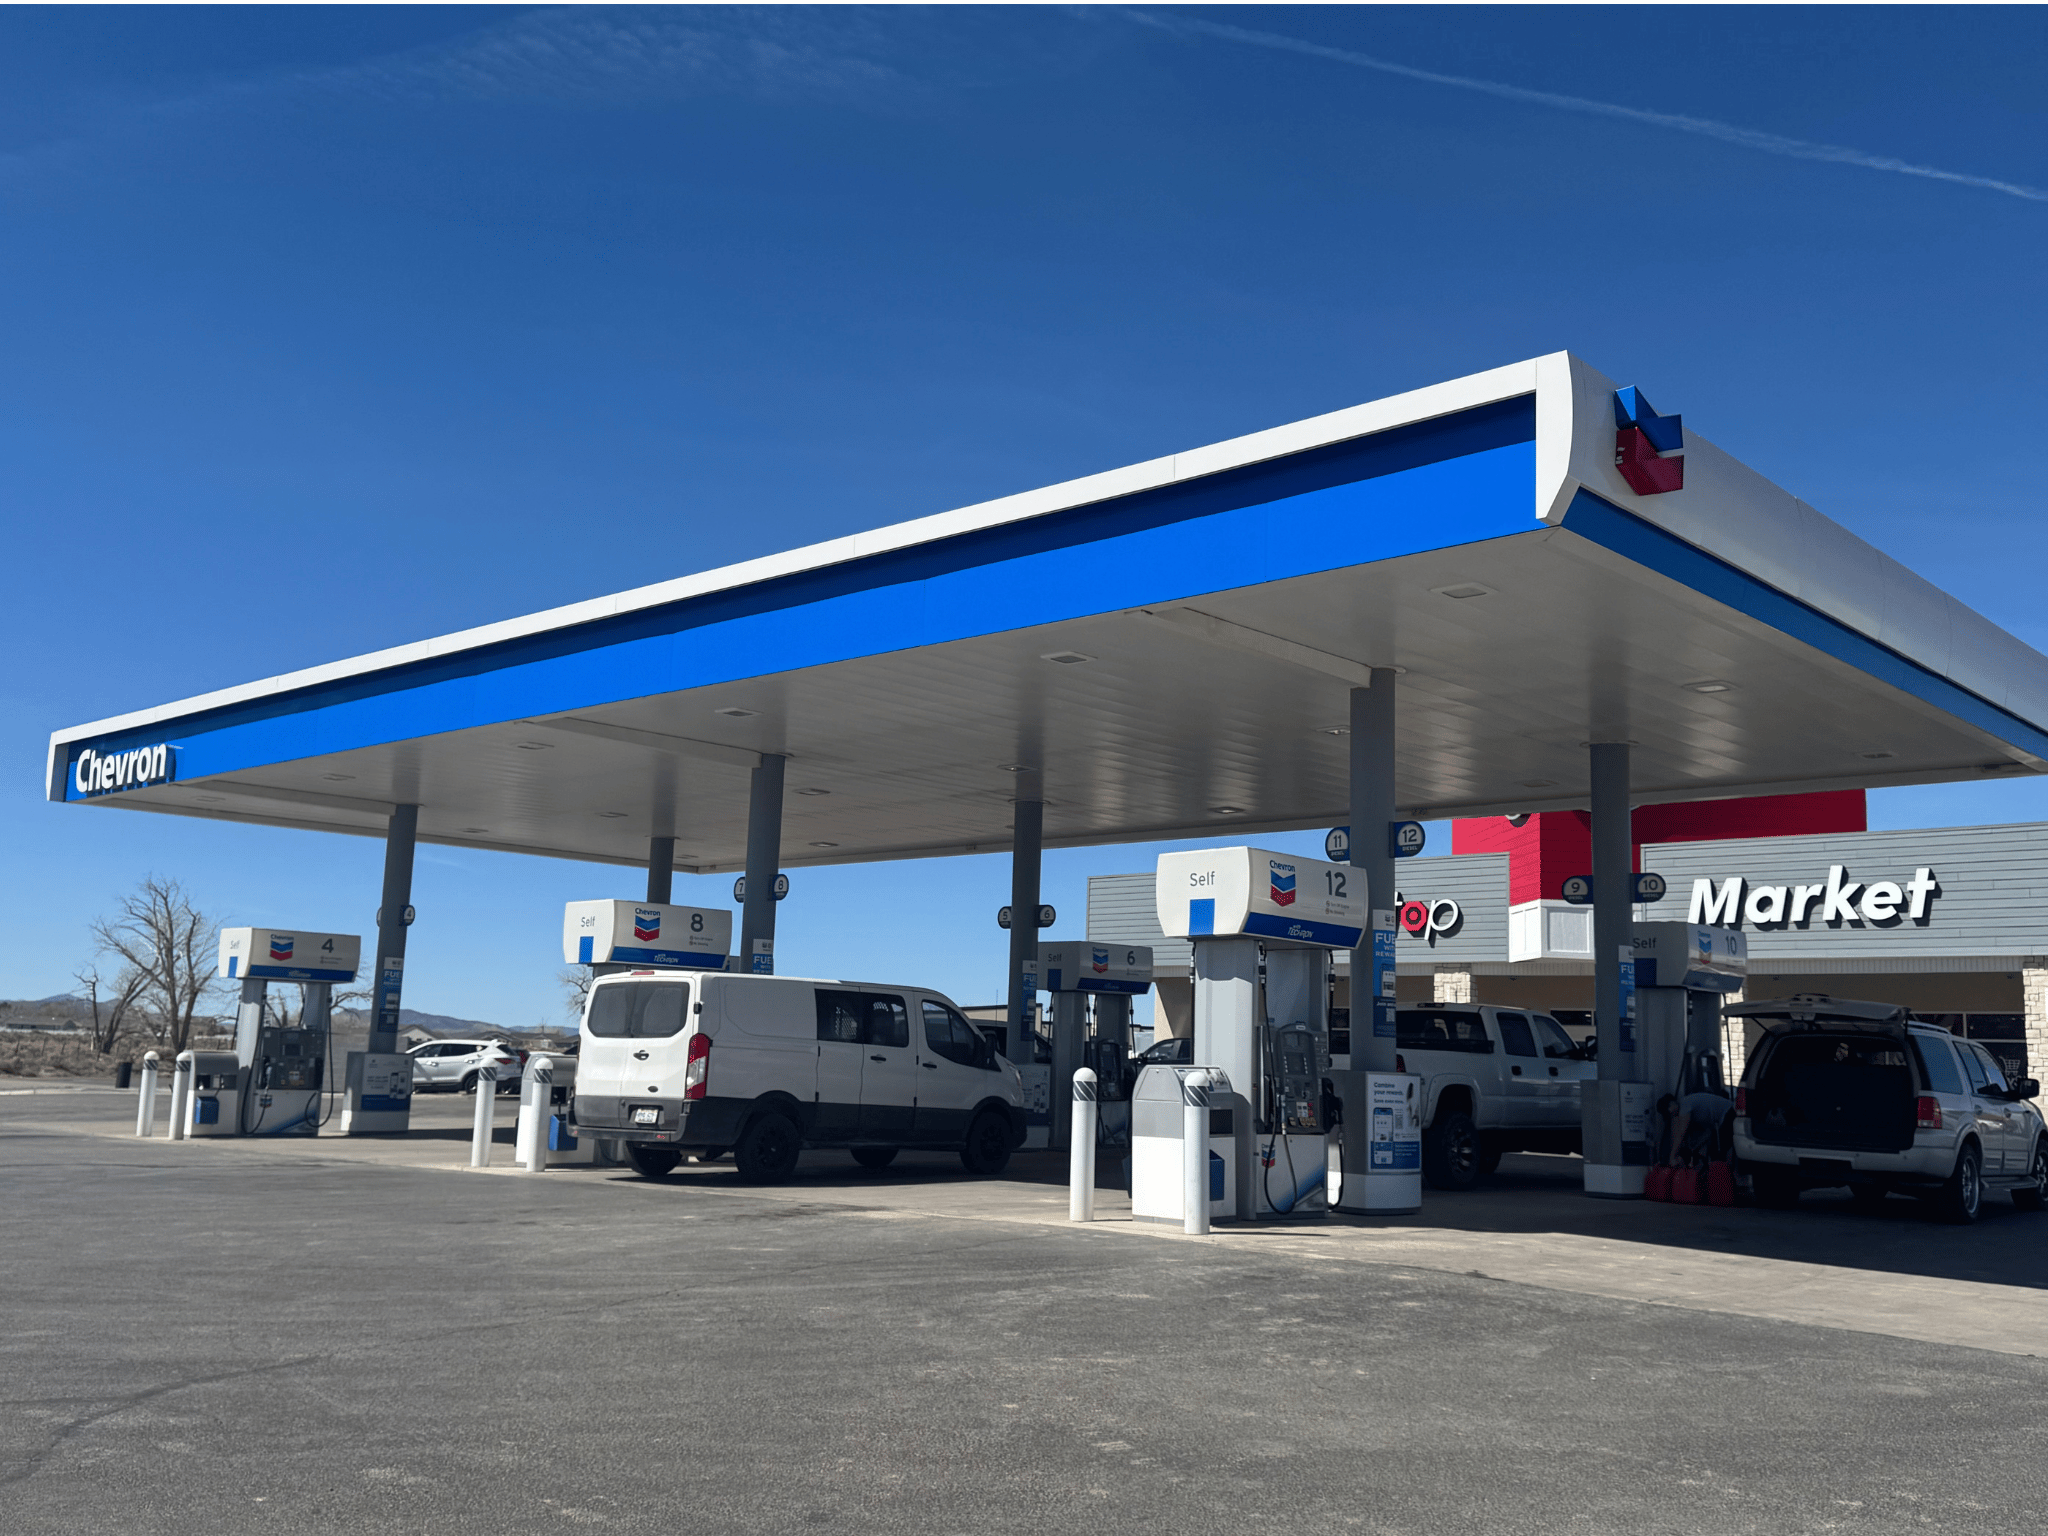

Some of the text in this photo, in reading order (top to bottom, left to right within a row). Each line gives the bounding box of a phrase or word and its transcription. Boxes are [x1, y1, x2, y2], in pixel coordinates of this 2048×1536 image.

[76, 743, 167, 793] Chevron
[1333, 834, 1342, 848] 11
[1402, 828, 1417, 843] 12
[1269, 859, 1296, 873] Chevron
[777, 880, 784, 891] 8
[1189, 871, 1216, 887] Self
[1325, 869, 1347, 899] 12
[1642, 879, 1658, 891] 10
[738, 882, 744, 893] 7
[1571, 882, 1580, 894] 9
[1687, 865, 1936, 925] Market
[634, 907, 661, 917] Chevron
[1002, 911, 1008, 920] 5
[1044, 909, 1051, 919] 6
[581, 916, 595, 928] Self
[690, 913, 704, 933] 8
[321, 938, 334, 954] 4
[1633, 937, 1657, 949] Self
[1725, 935, 1737, 956] 10
[1047, 953, 1062, 962] Self
[1127, 950, 1136, 966] 6
